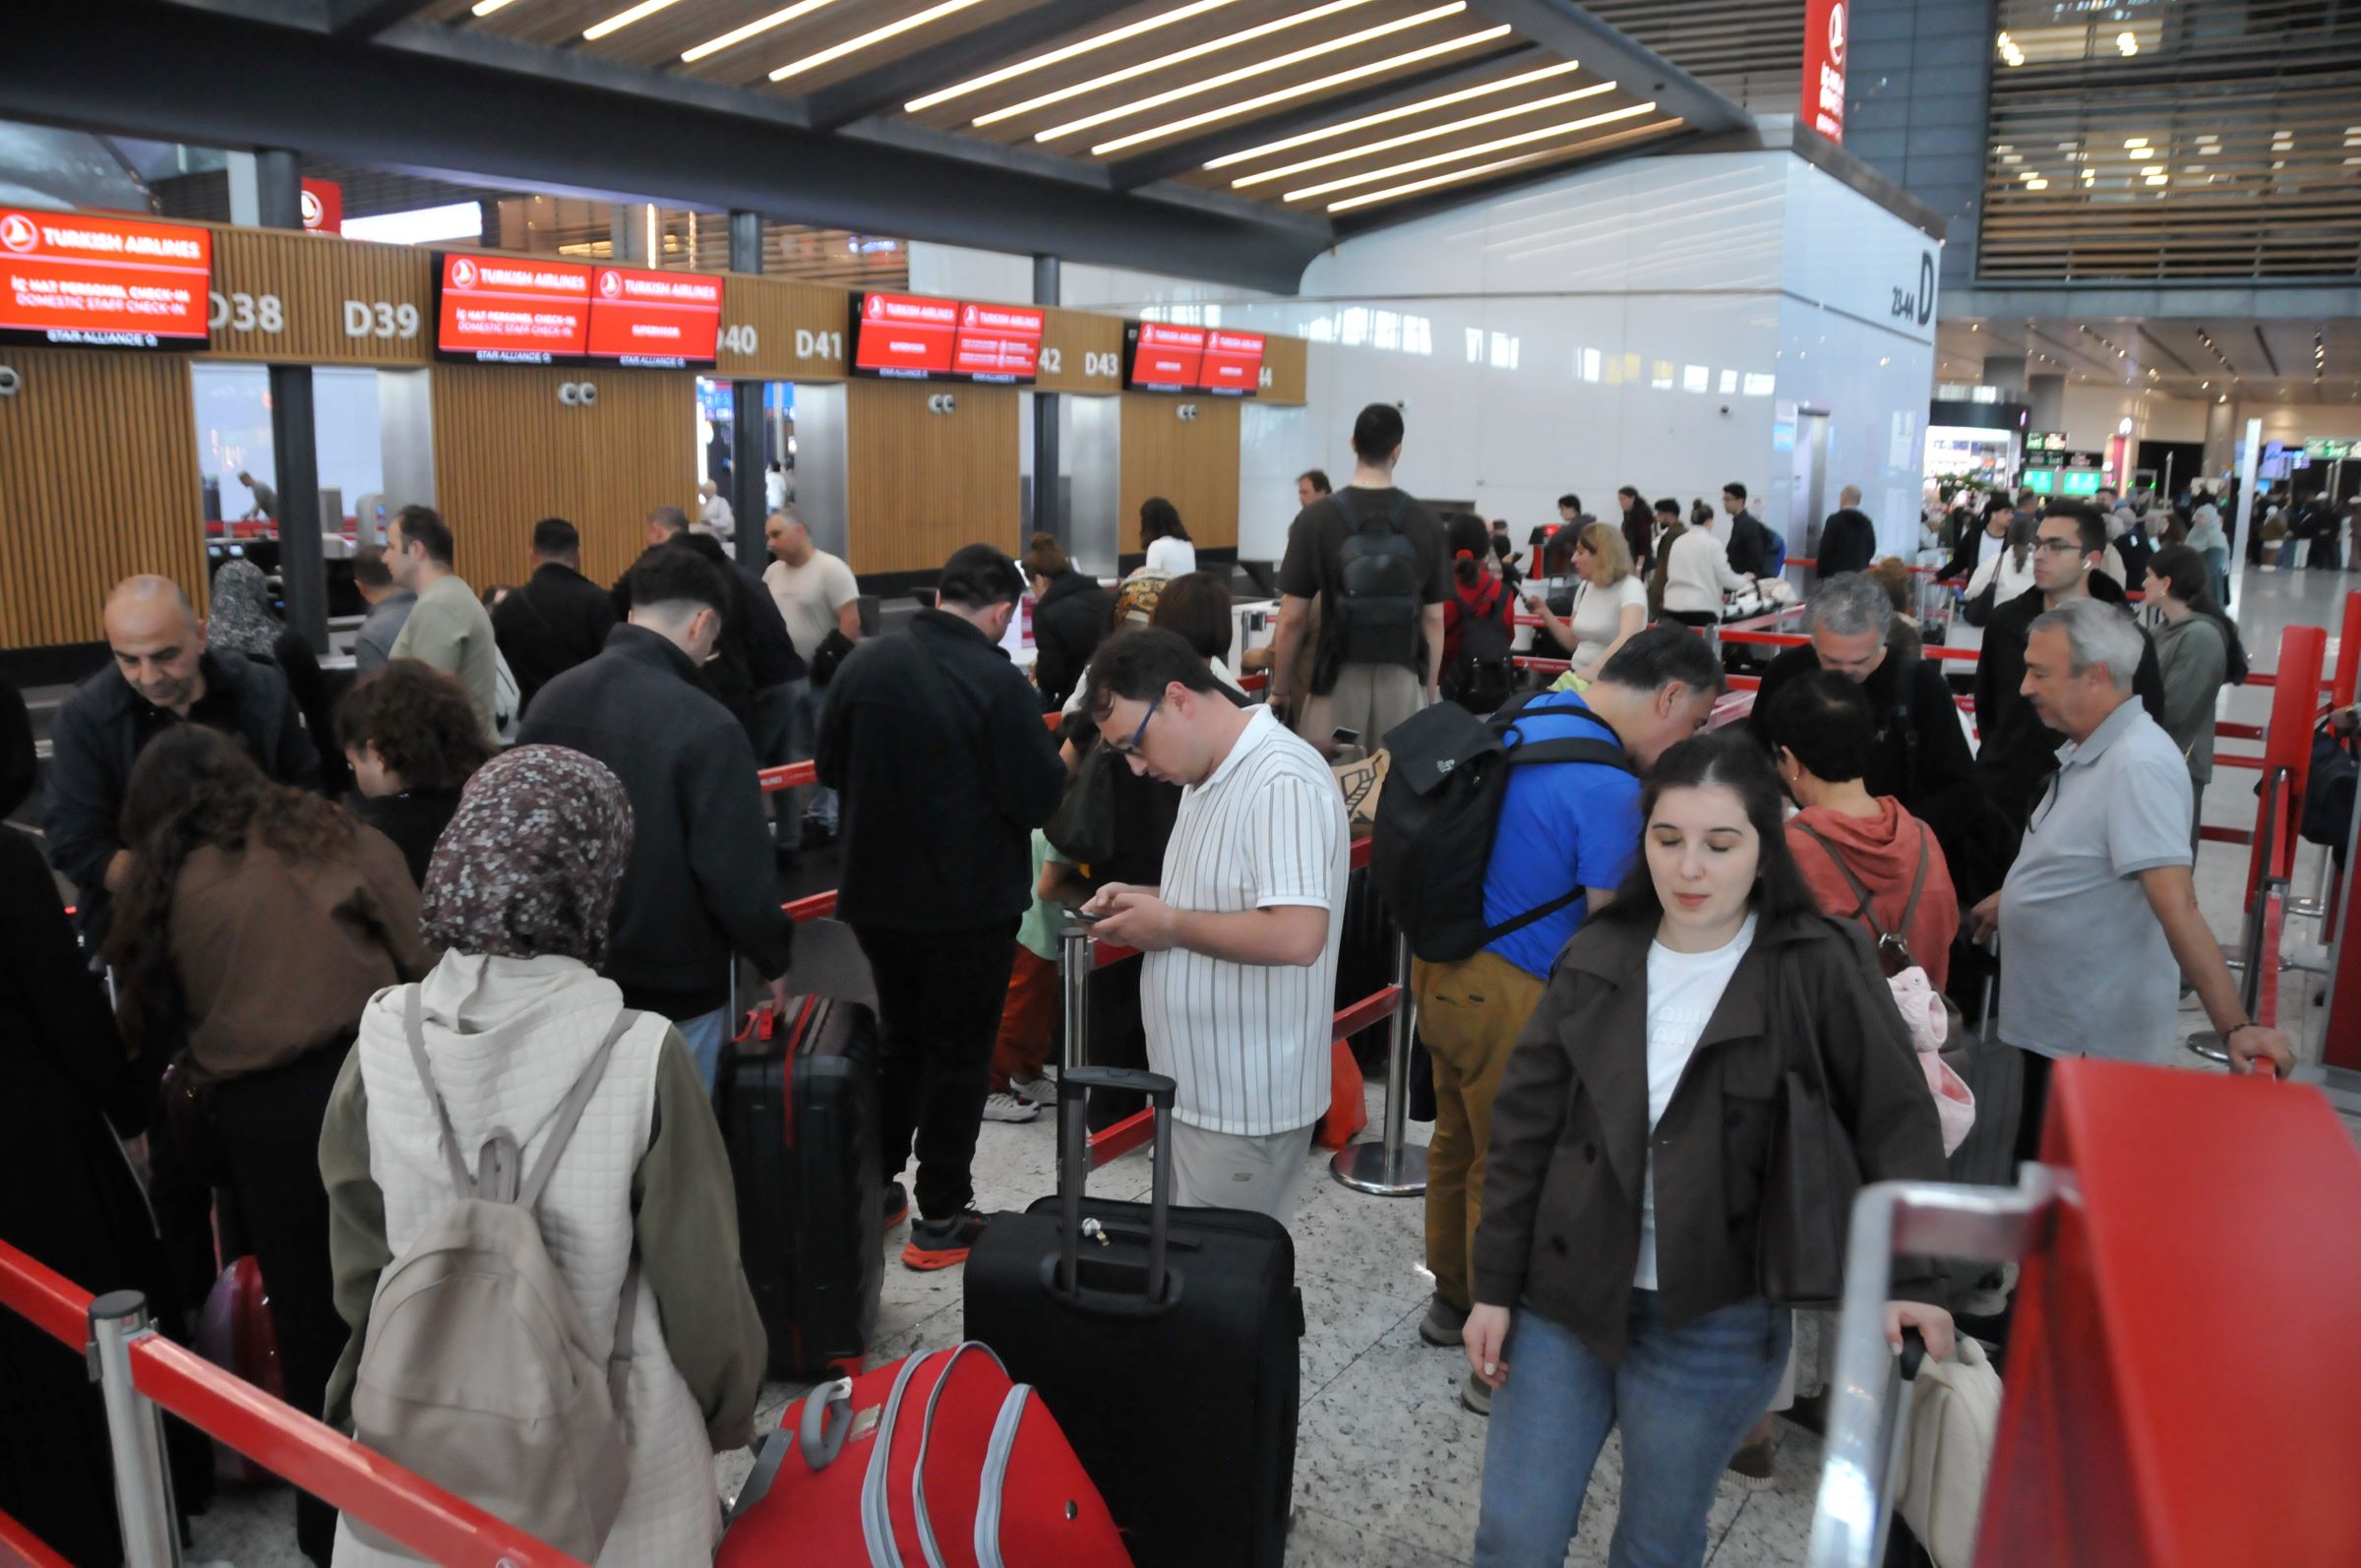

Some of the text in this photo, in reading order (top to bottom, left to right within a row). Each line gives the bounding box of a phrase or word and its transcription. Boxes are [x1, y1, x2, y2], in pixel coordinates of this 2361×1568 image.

[42, 227, 202, 260] TURKISH AIRLINES
[29, 278, 58, 293] HAT
[59, 280, 127, 299] PERSONEL
[129, 286, 190, 303] CHECK-IN
[480, 268, 587, 291] TURKISH AIRLINES
[624, 279, 717, 300] TURKISH AIRLINES
[1918, 249, 1934, 326] D
[16, 293, 187, 316] DOMESTIC STAFF CHECK-IN
[886, 302, 954, 322] TURKISH AIRLINES
[344, 300, 419, 339] D39
[457, 321, 503, 334] DOMESTIC
[534, 314, 577, 327] CHECK-IN
[980, 311, 1040, 328] TURKISH AIRLINES
[47, 329, 145, 346] STAR ALLIANCE
[795, 329, 843, 361] D41
[476, 350, 542, 363] STAR ALLIANCE
[620, 355, 676, 368] STAR ALLIANCE
[1085, 351, 1119, 377] D43
